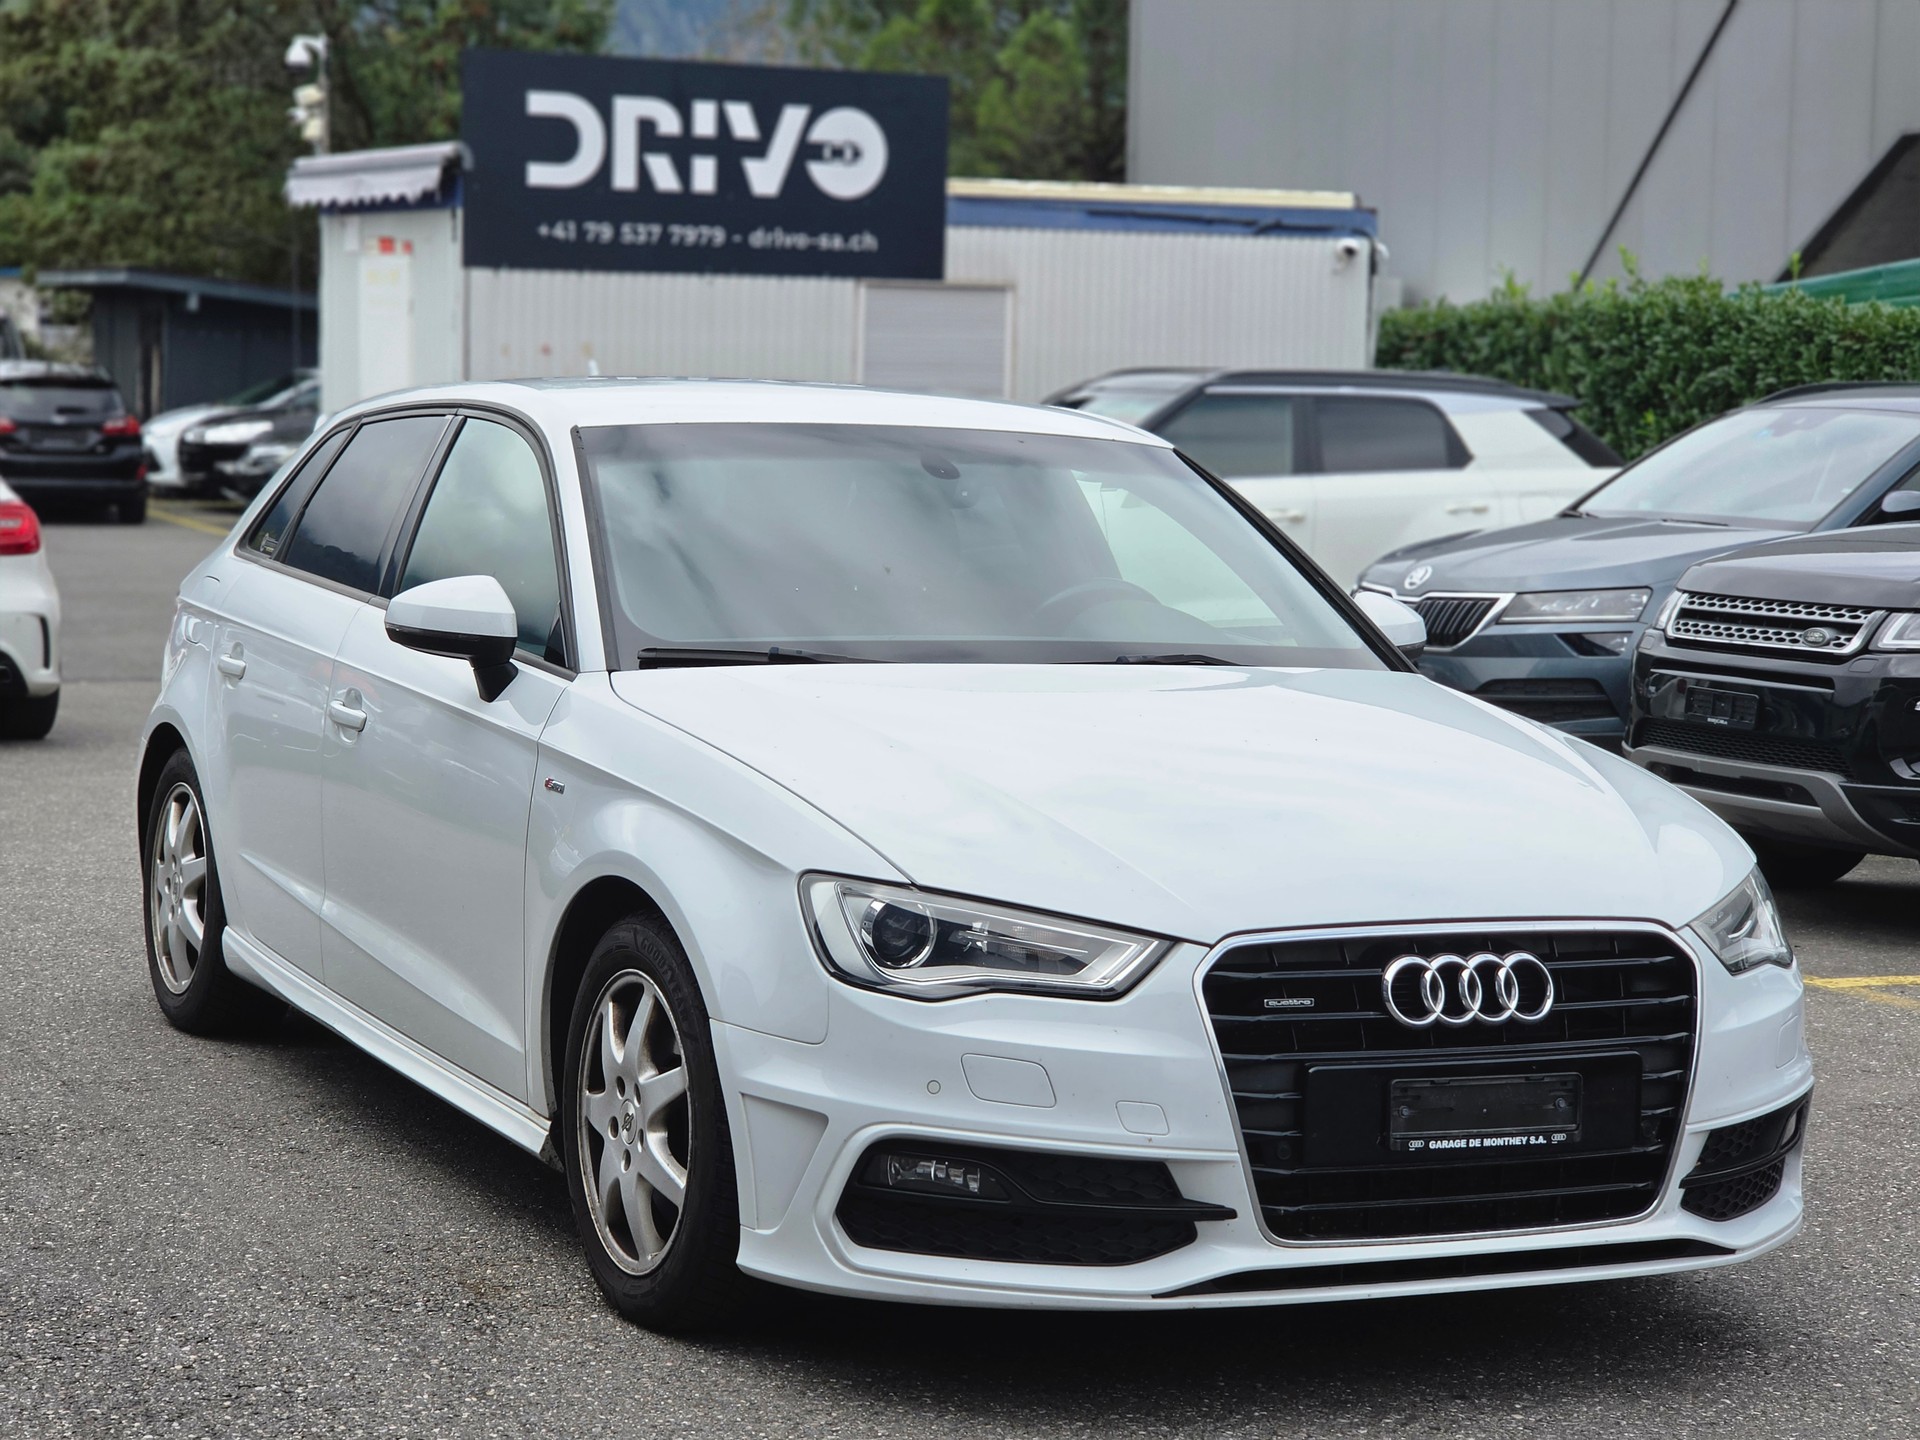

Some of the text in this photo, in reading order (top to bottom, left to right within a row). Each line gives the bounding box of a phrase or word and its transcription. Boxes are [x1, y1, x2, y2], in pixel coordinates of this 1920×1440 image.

[525, 89, 889, 200] DRIVO
[537, 220, 577, 242] +41
[582, 221, 615, 245] 79
[619, 222, 663, 246] 537
[667, 224, 727, 249] 7979
[748, 226, 878, 253] drivo-sa.ch
[1268, 999, 1311, 1007] quattro
[1429, 1135, 1547, 1149] GARAGE DE MONTHEY S.A.
